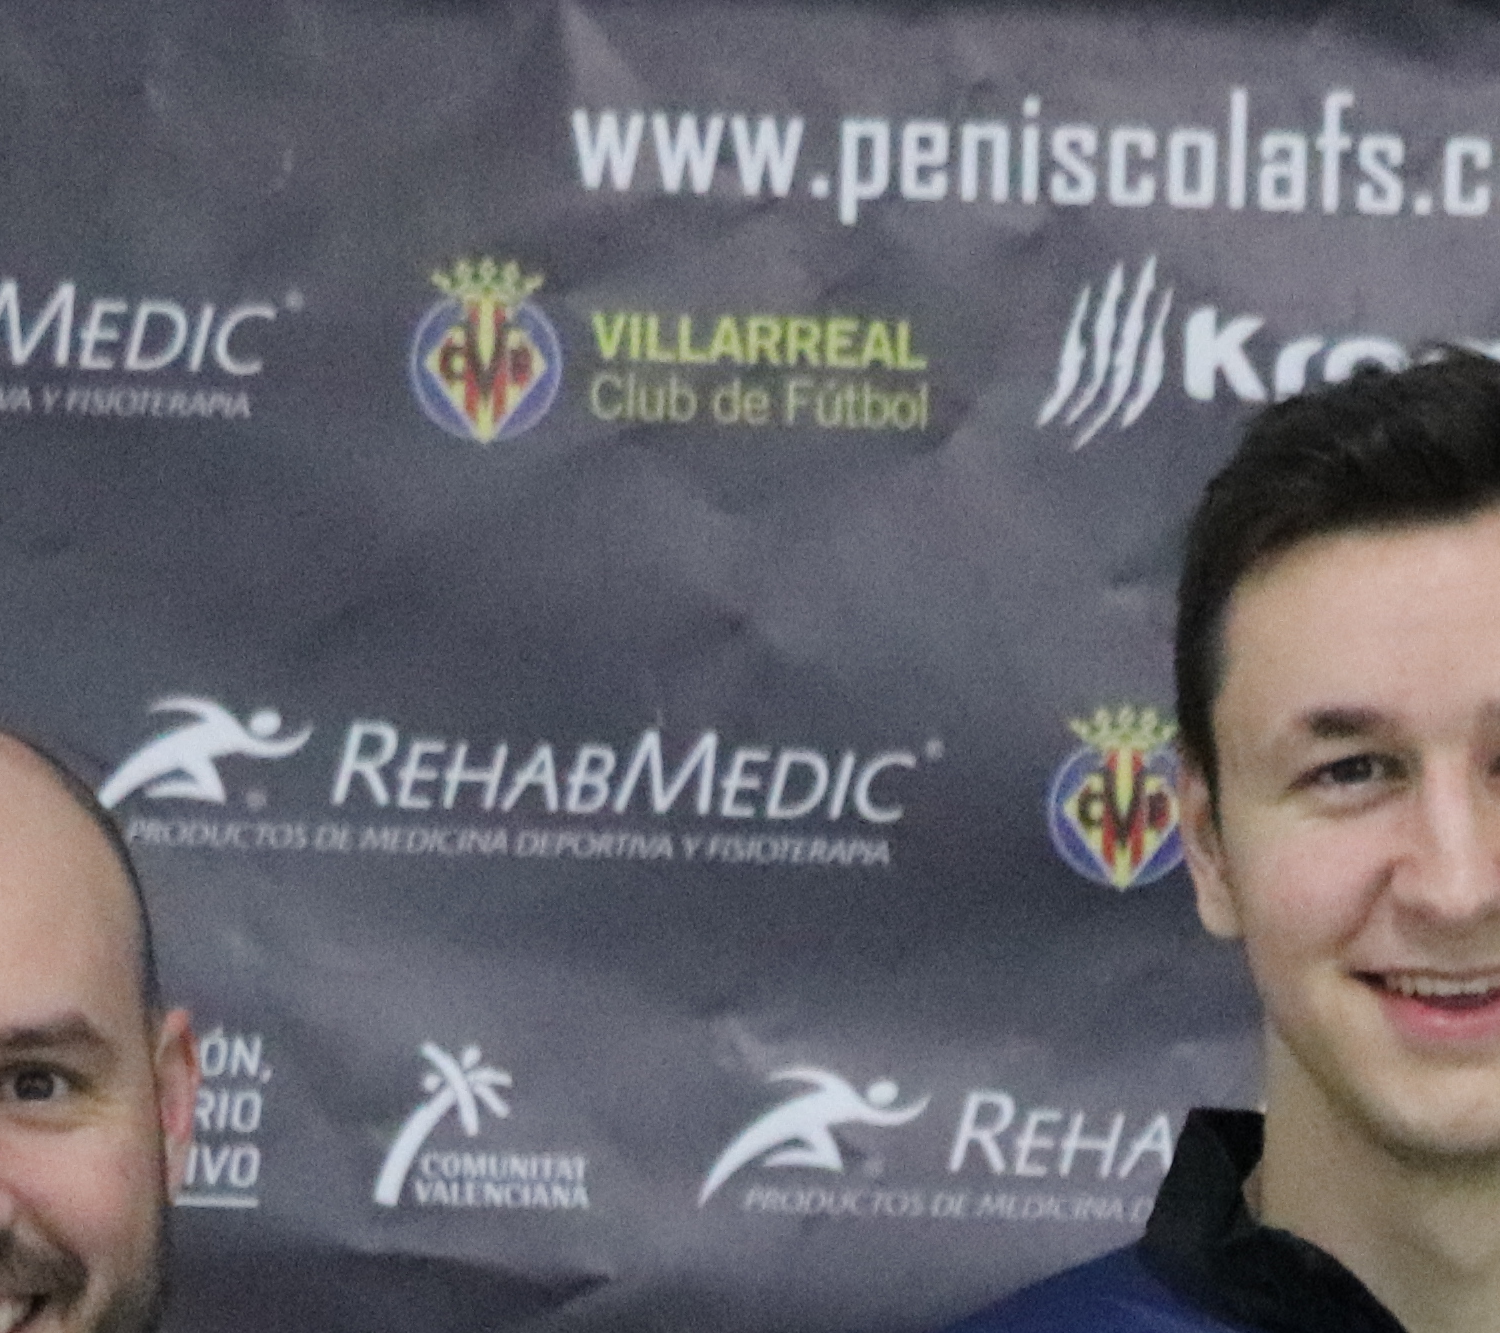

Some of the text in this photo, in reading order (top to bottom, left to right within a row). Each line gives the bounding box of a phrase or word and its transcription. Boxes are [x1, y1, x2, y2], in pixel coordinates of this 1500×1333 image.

[591, 311, 928, 372] VILLARREAL
[590, 373, 930, 434] Club de Fútbol
[418, 1151, 587, 1182] COMUNITAT
[414, 1177, 590, 1211] VALENCIANA
